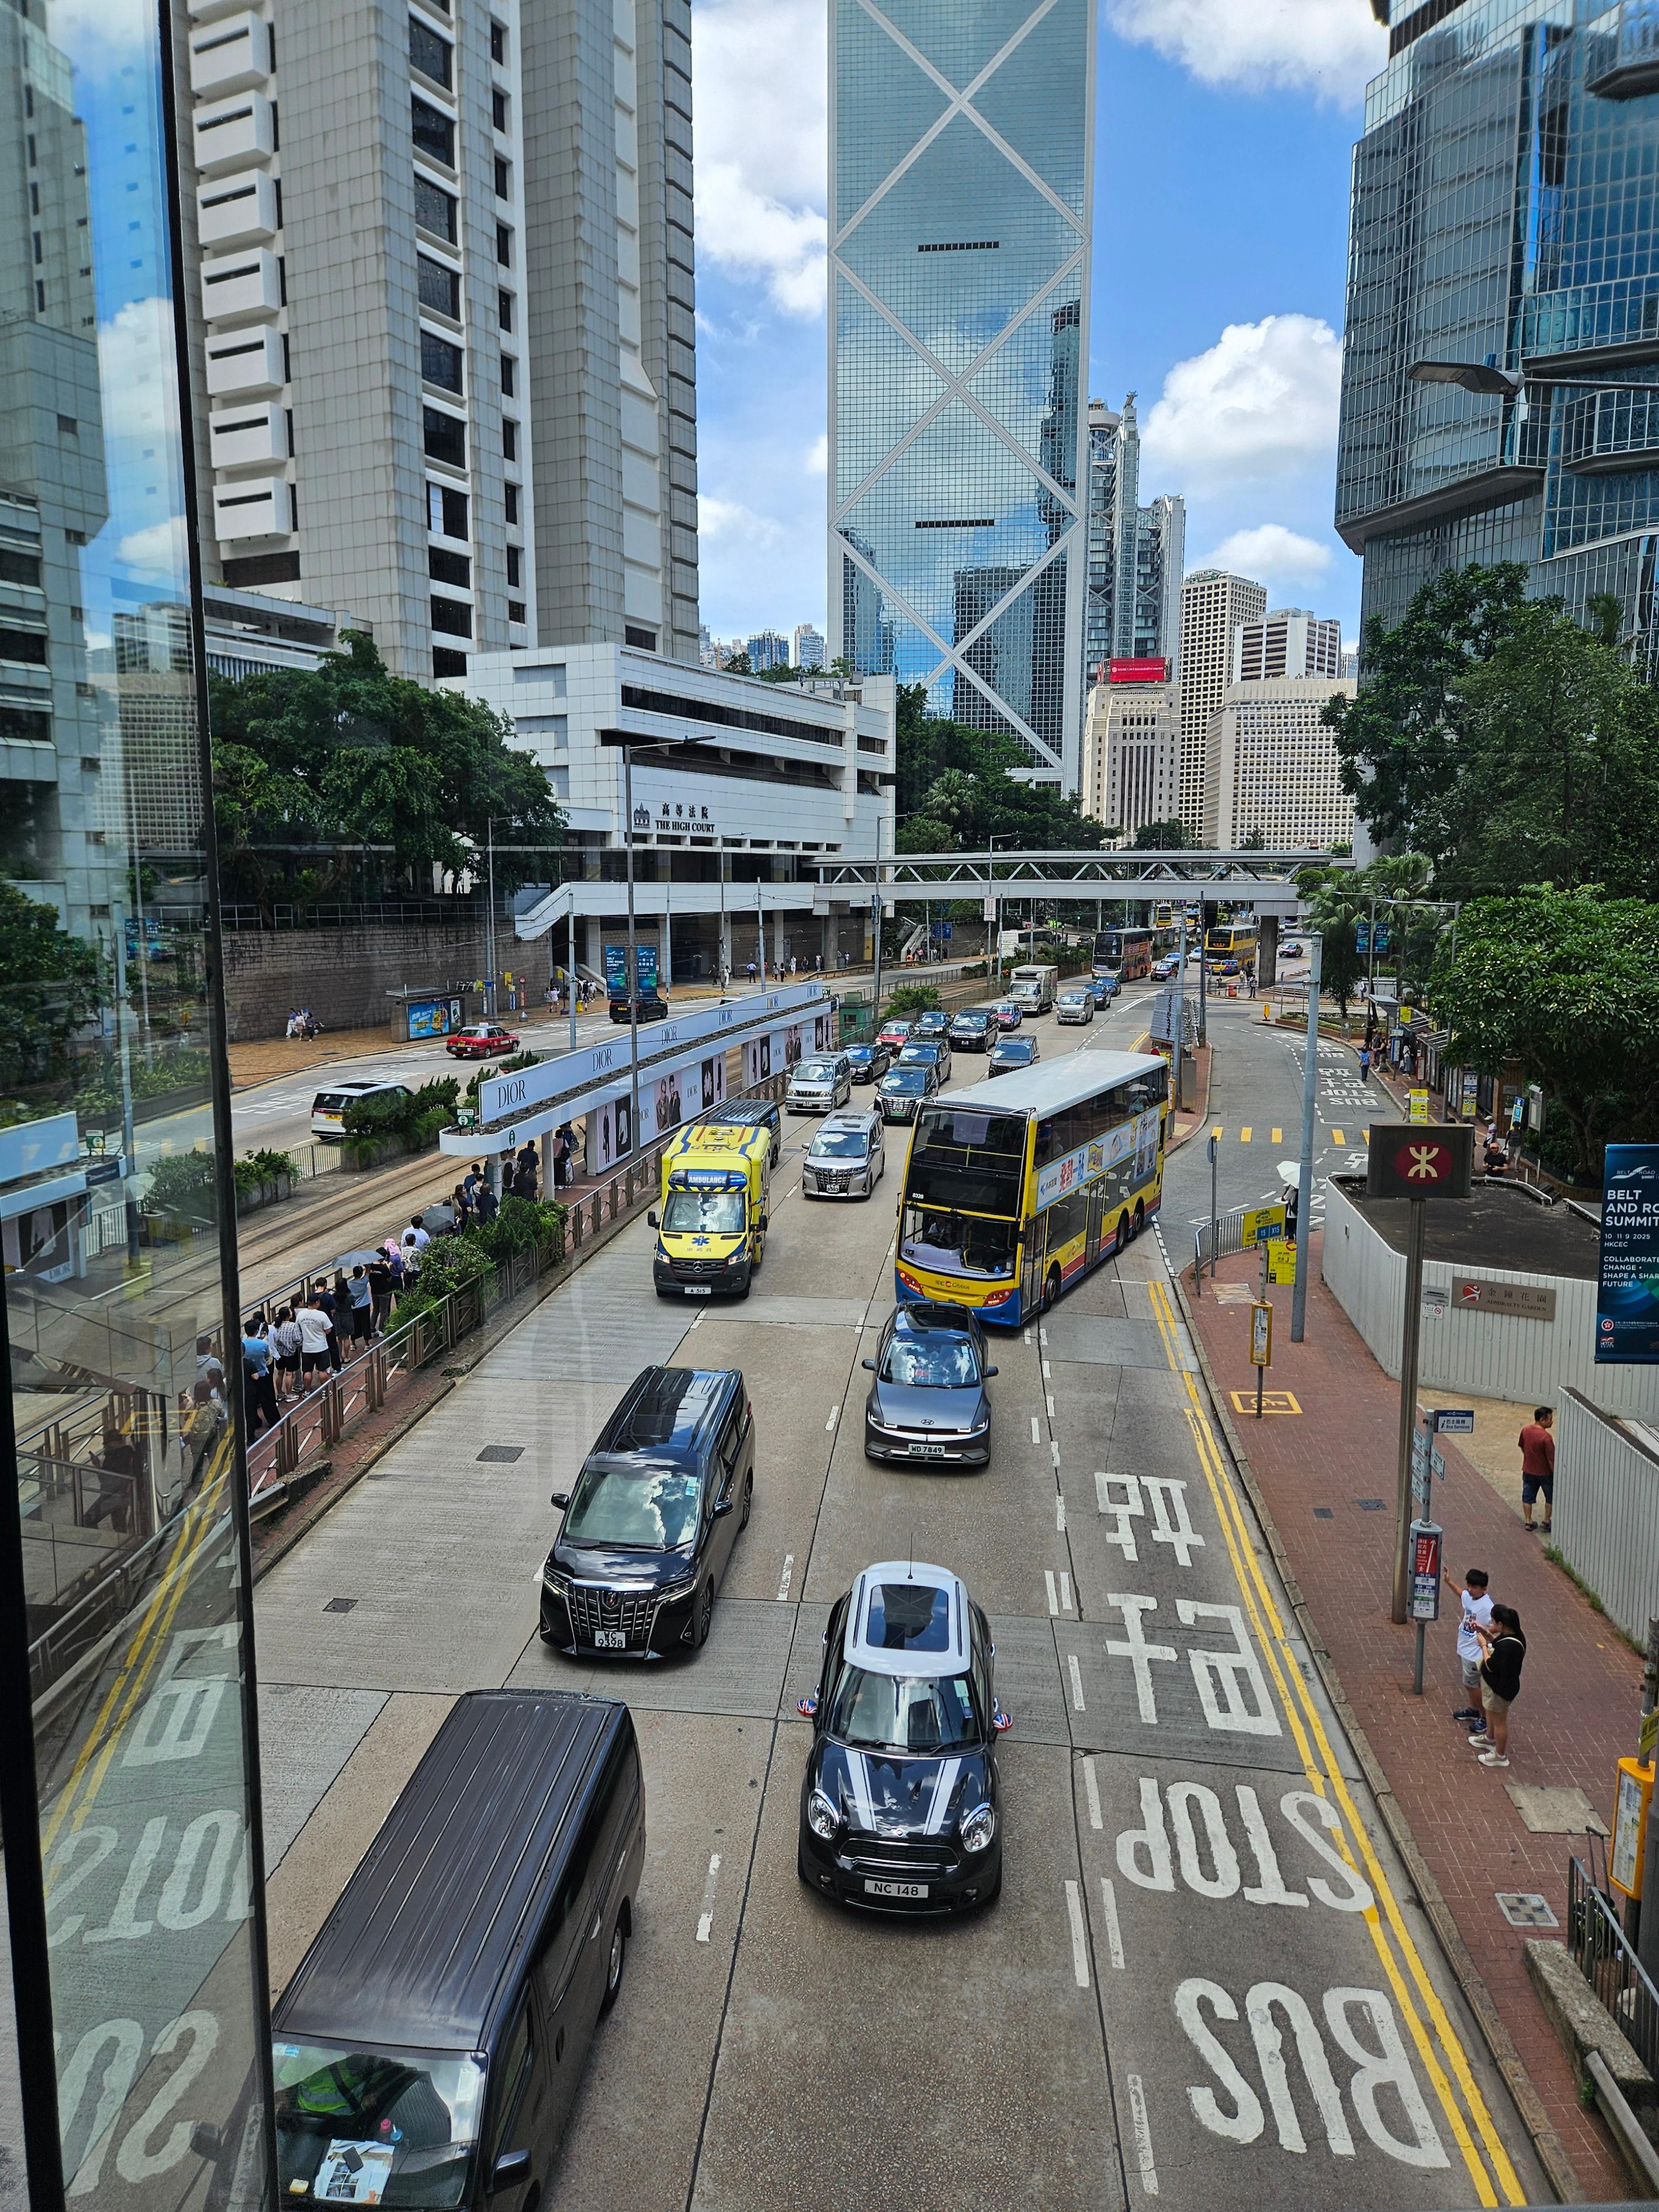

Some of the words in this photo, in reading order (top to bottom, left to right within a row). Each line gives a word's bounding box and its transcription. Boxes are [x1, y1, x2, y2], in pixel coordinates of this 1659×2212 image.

[662, 802, 708, 819] 高等法院
[655, 820, 670, 830] THE
[672, 821, 690, 831] HIGH
[692, 822, 715, 832] COURT
[719, 1009, 733, 1025] DIOR
[661, 1026, 677, 1045] DIOR
[593, 1048, 612, 1071] DIOR
[1321, 1078, 1366, 1088] 巴士
[498, 1079, 526, 1108] DIOR
[687, 1085, 698, 1098] DIOR
[639, 1108, 649, 1121] IOR
[1607, 1190, 1642, 1199] BELT
[1606, 1203, 1638, 1213] AND
[1605, 1215, 1659, 1227] SUMMIT
[1487, 1288, 1547, 1303] 金鐘花園
[1486, 1300, 1520, 1308] ADMIRALTY
[1095, 1472, 1205, 1567] 站
[603, 1631, 617, 1640] WC
[598, 1639, 623, 1648] 9398
[1106, 1593, 1282, 1736] 巴士
[1116, 1776, 1375, 1912] STOP
[874, 1882, 891, 1894] NC
[897, 1885, 919, 1896] 148
[1173, 1978, 1451, 2169] BUS
